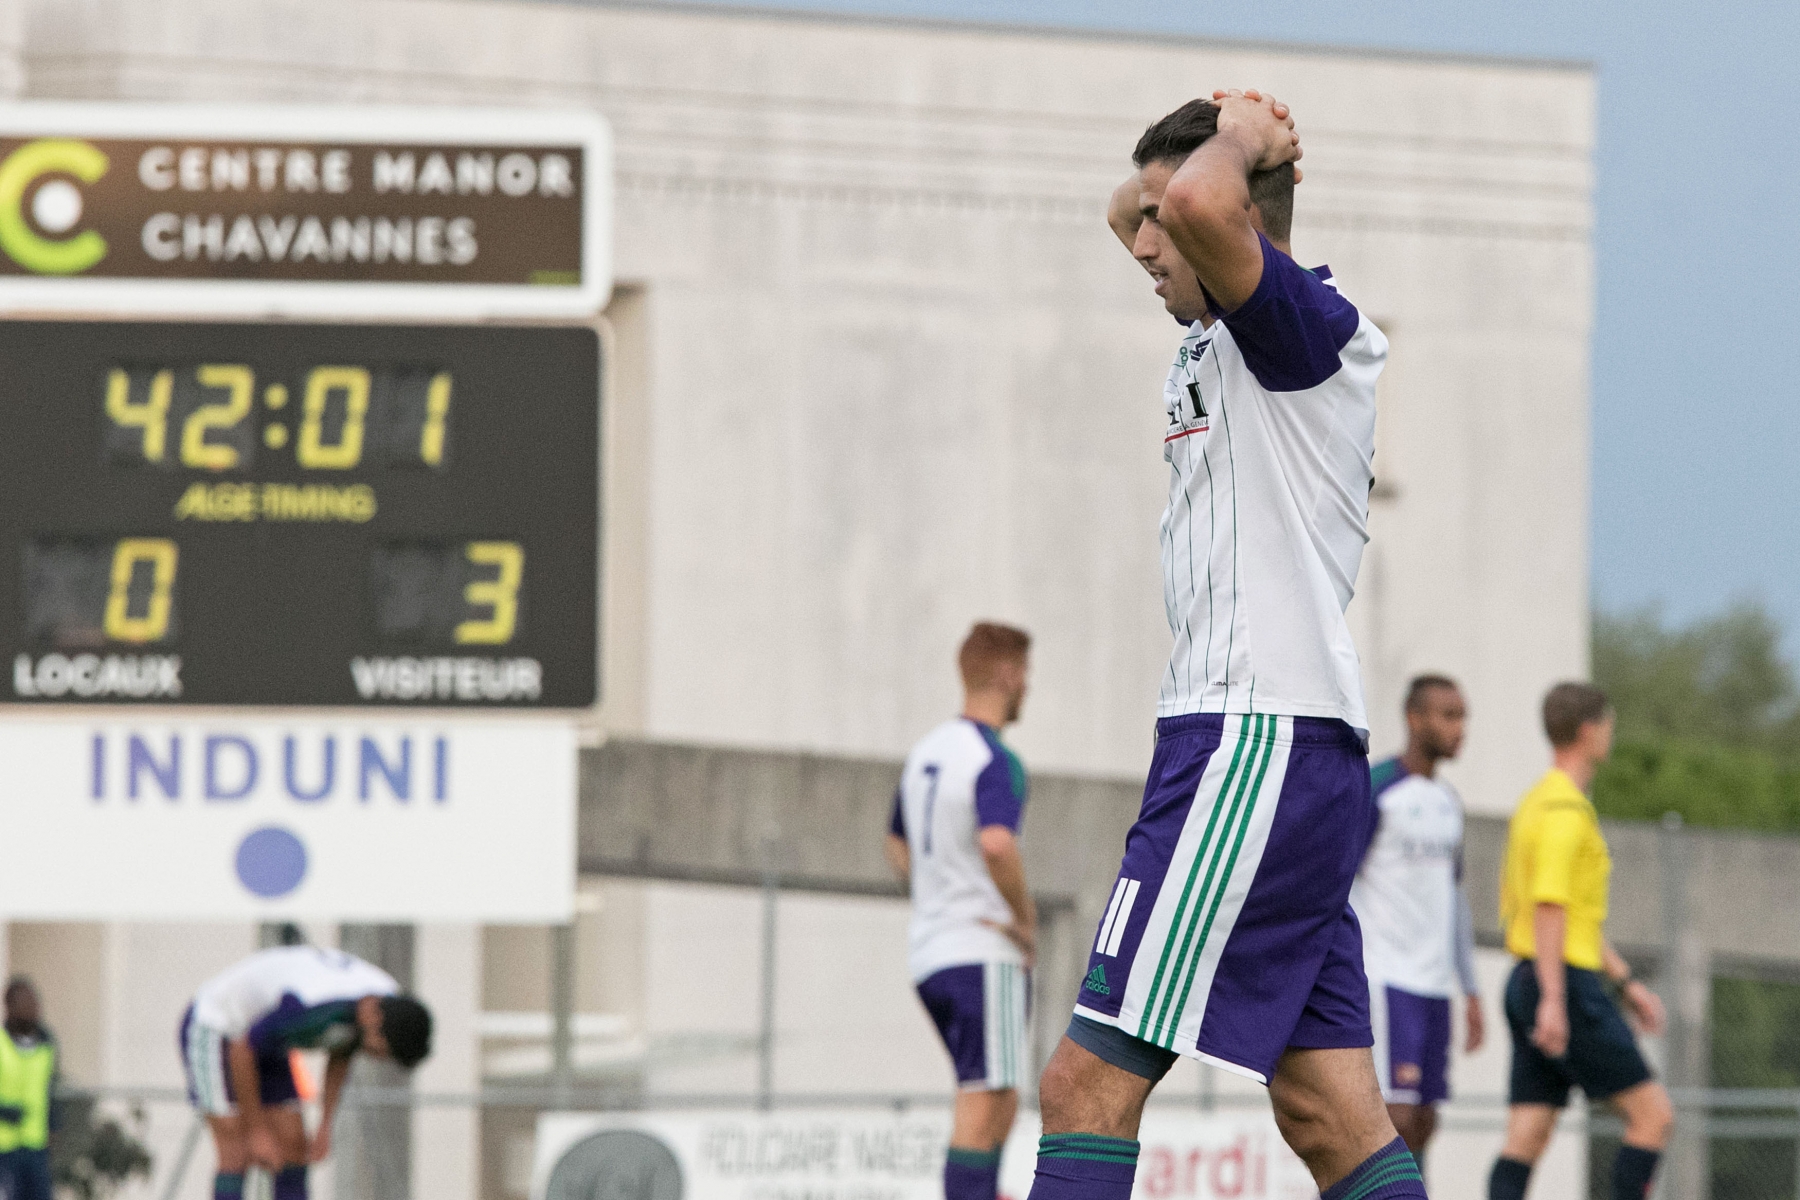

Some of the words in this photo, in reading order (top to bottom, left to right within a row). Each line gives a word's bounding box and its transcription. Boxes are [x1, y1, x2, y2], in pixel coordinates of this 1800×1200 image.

[138, 147, 351, 193] CENTRE
[374, 152, 573, 197] MANOR
[141, 212, 478, 265] CHAVANNES
[105, 364, 452, 468] 42:01
[104, 537, 178, 642] 0
[453, 541, 524, 644] 3
[13, 652, 183, 698] LOCAUX
[350, 655, 543, 700] VISITEUR
[91, 733, 448, 804] INDUNI
[1096, 877, 1141, 957] 11
[1085, 979, 1110, 995] adidas
